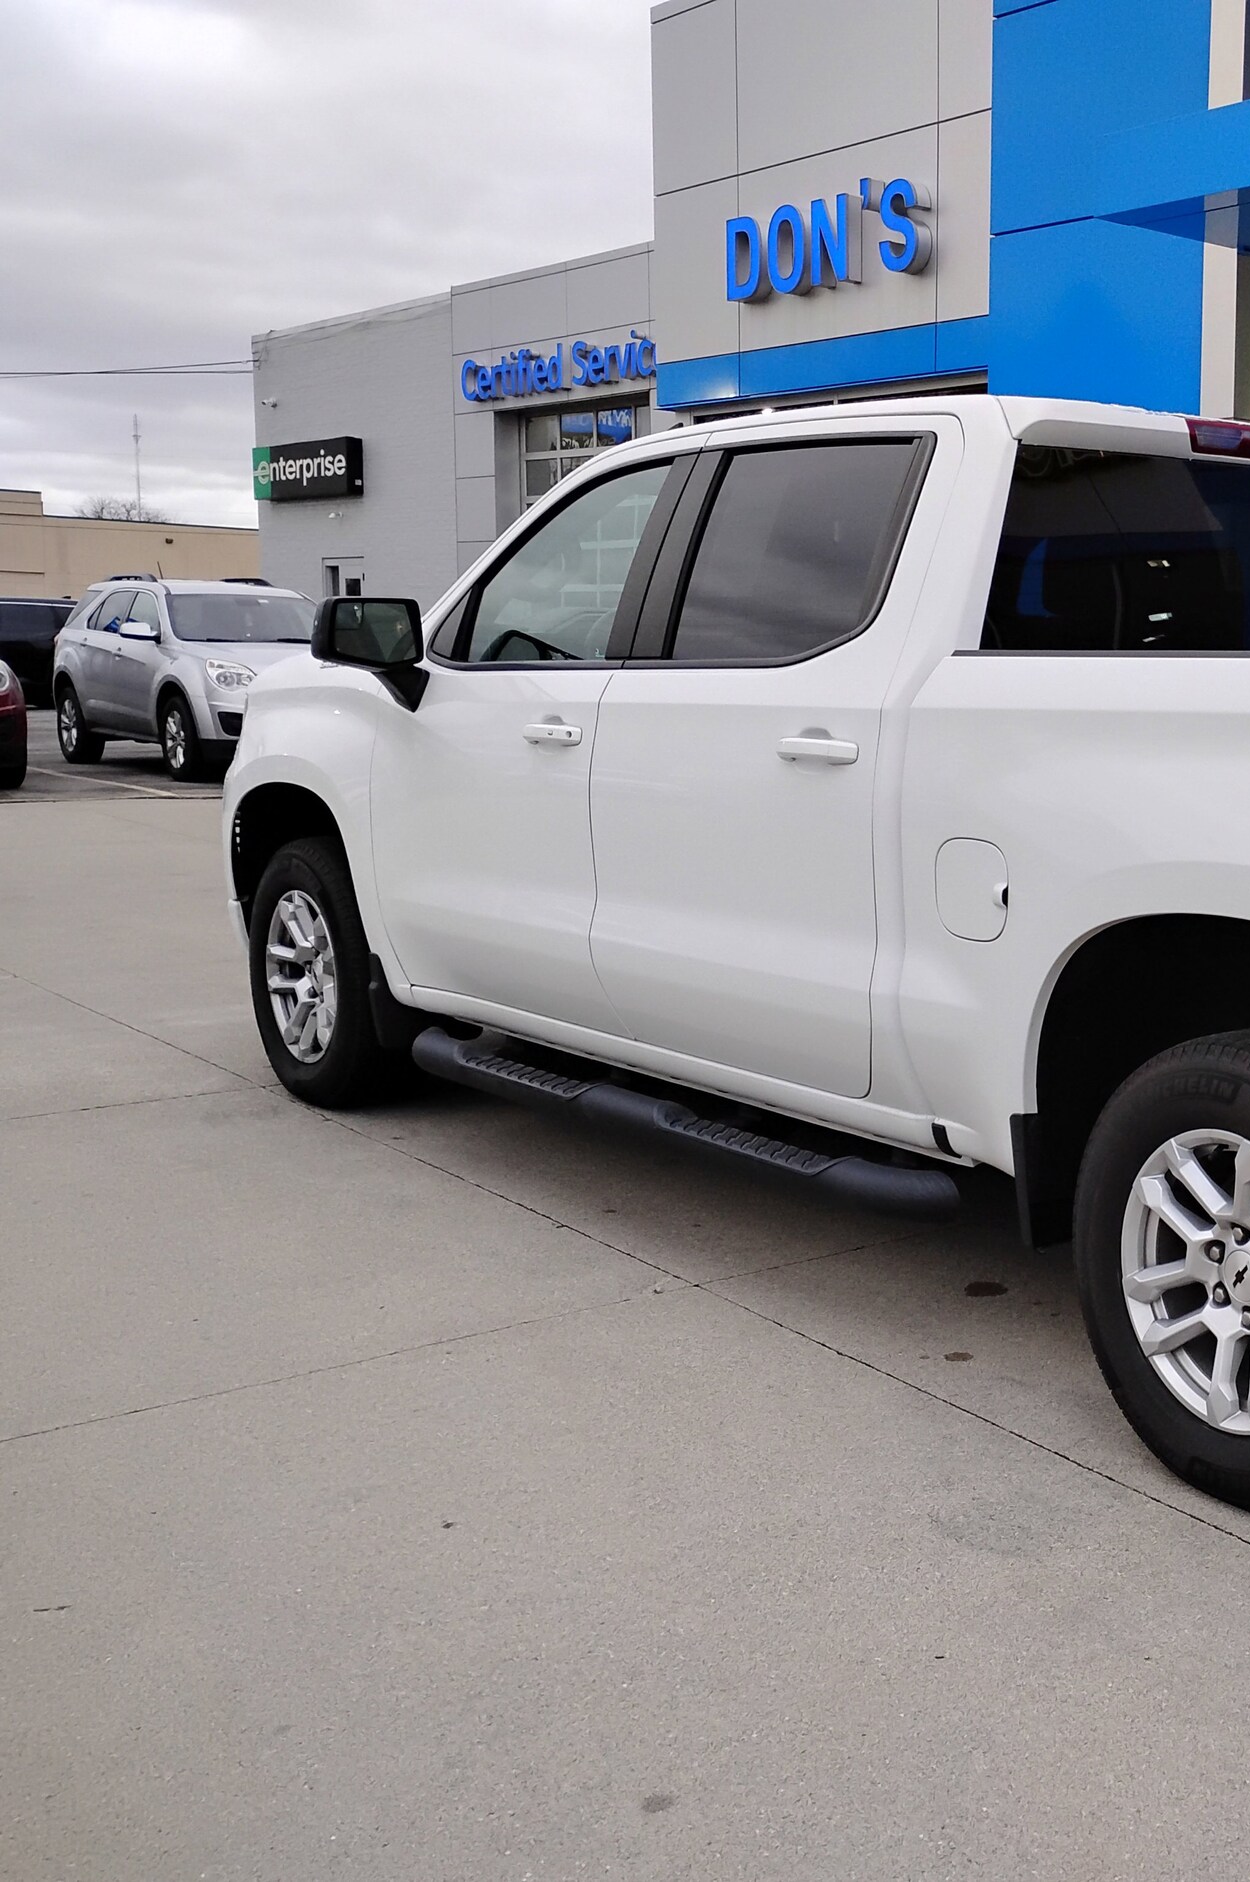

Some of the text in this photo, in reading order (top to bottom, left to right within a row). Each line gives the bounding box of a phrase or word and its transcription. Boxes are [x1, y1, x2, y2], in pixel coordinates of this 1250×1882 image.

[726, 177, 926, 301] DON'S
[461, 329, 656, 401] Certified Servic
[256, 448, 346, 486] enterprise
